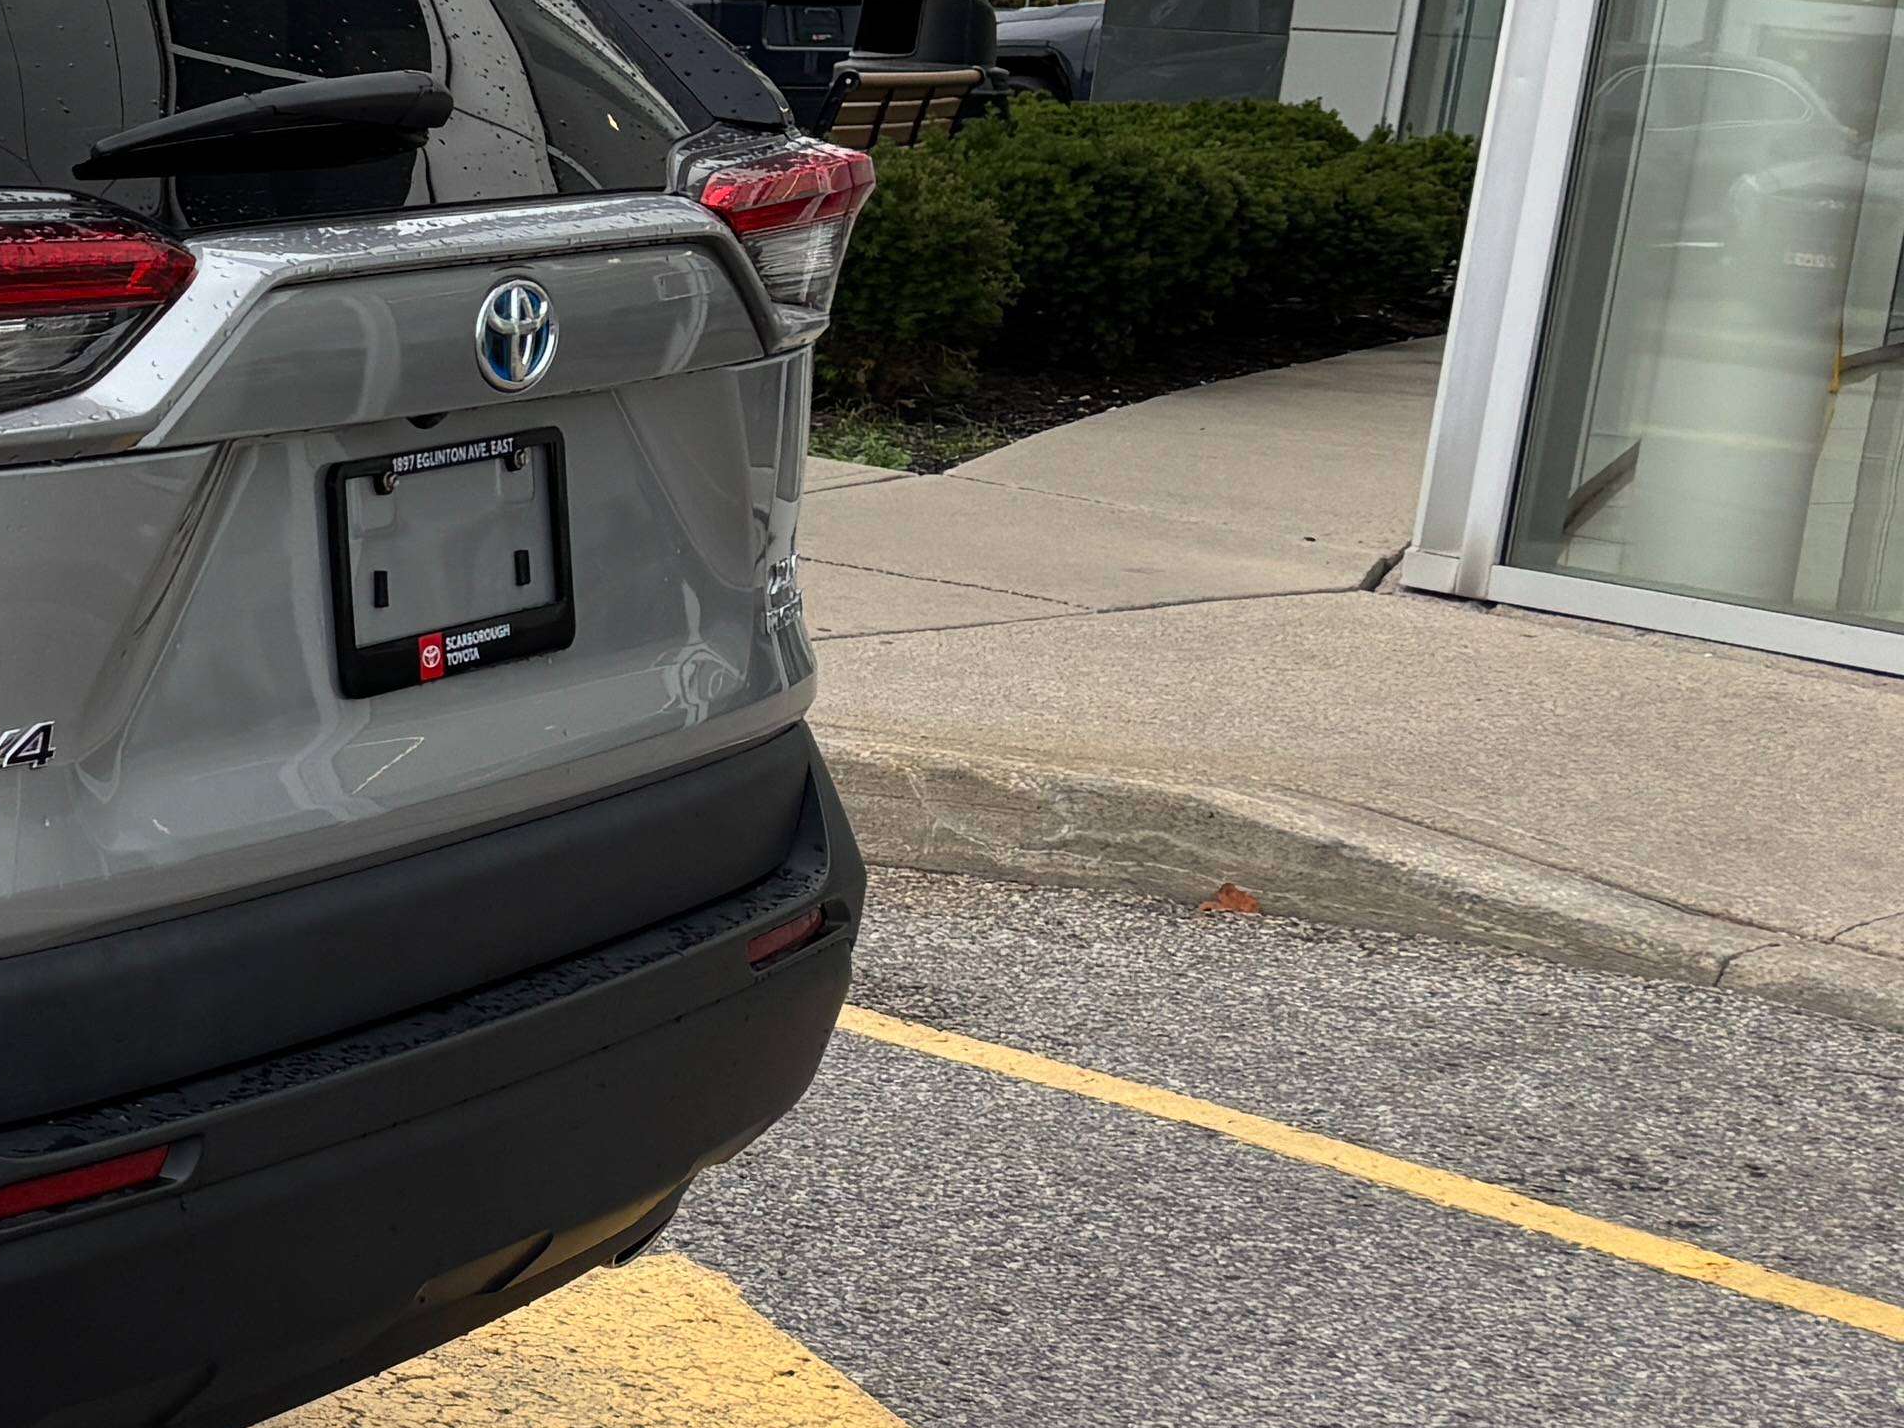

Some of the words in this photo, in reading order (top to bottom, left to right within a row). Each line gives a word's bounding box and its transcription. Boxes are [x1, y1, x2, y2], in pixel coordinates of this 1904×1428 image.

[392, 455, 414, 472] 1897
[490, 438, 514, 455] EAST
[445, 624, 510, 650] SCARBOROUGH
[446, 647, 480, 665] TOYOTA
